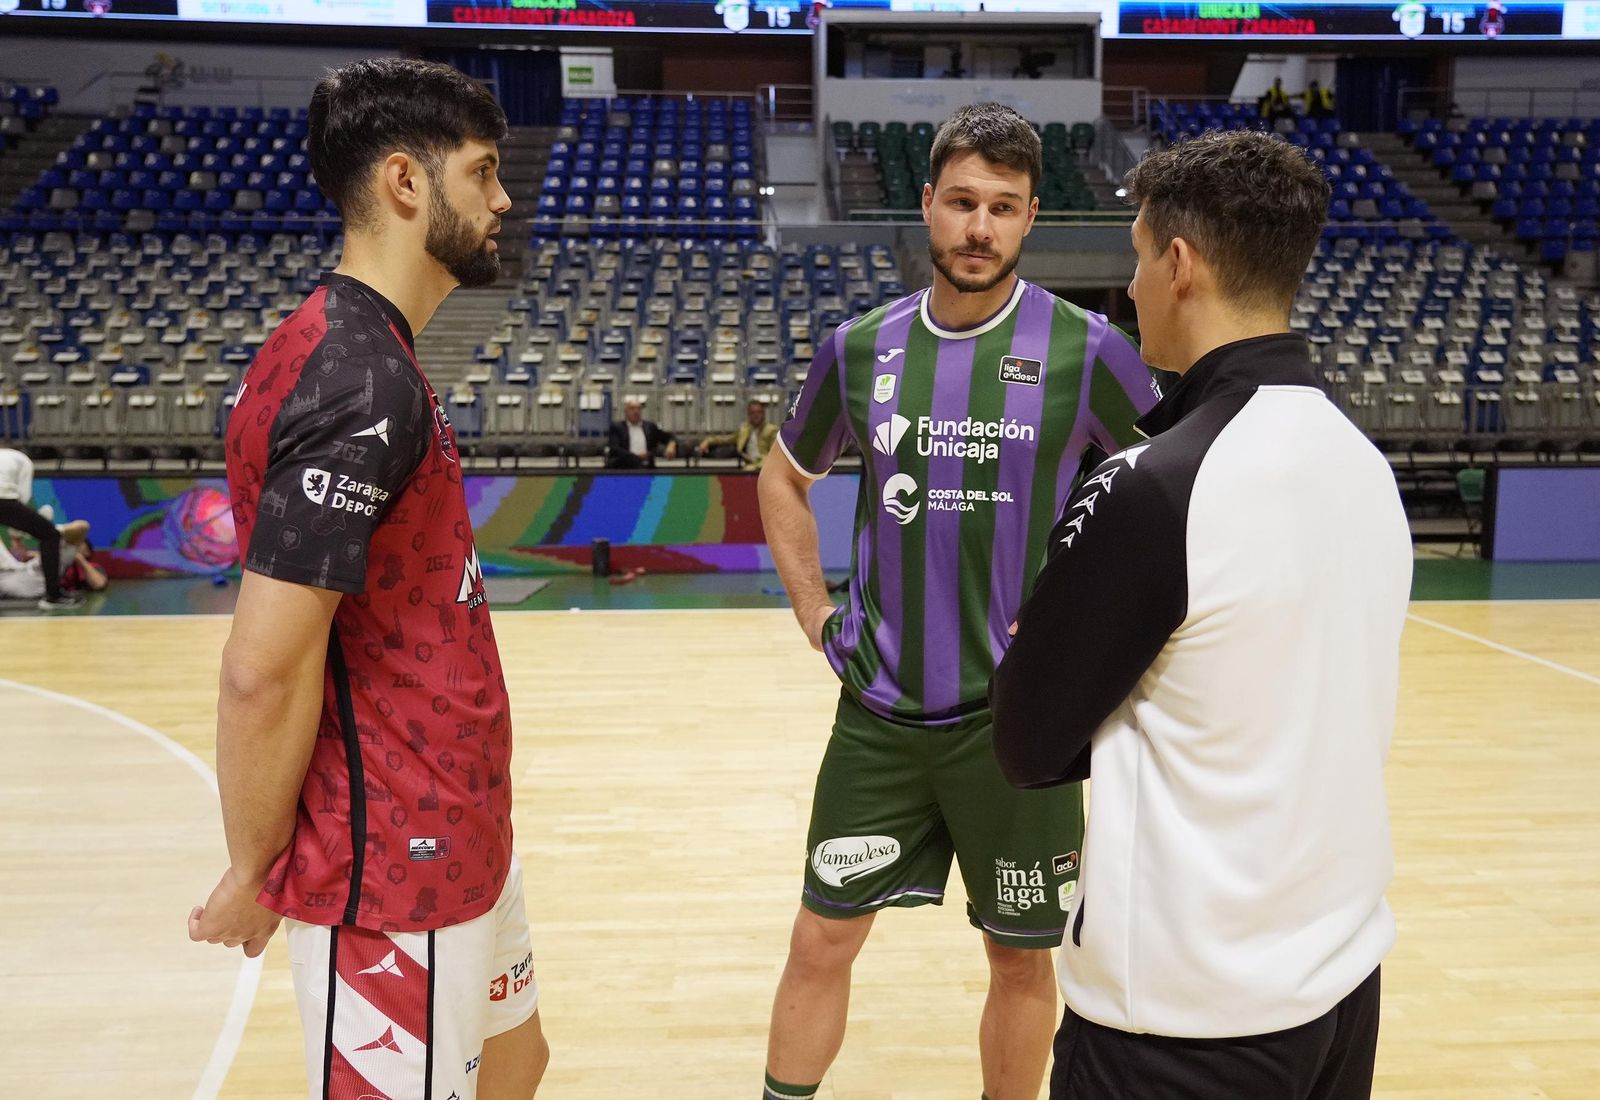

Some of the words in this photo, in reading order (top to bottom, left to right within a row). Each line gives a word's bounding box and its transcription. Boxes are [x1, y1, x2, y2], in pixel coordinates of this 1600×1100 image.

[766, 8, 792, 28] 15
[1442, 12, 1466, 33] 15
[1003, 363, 1021, 373] liga
[1003, 372, 1038, 383] endesa
[917, 416, 1035, 441] Fundación
[916, 437, 999, 464] Unicaja
[928, 489, 965, 500] COSTA
[966, 490, 990, 501] DEL
[991, 491, 1014, 502] SOL
[927, 500, 976, 512] MÁLAGA
[1056, 860, 1074, 872] acb
[996, 878, 1048, 910] laga
